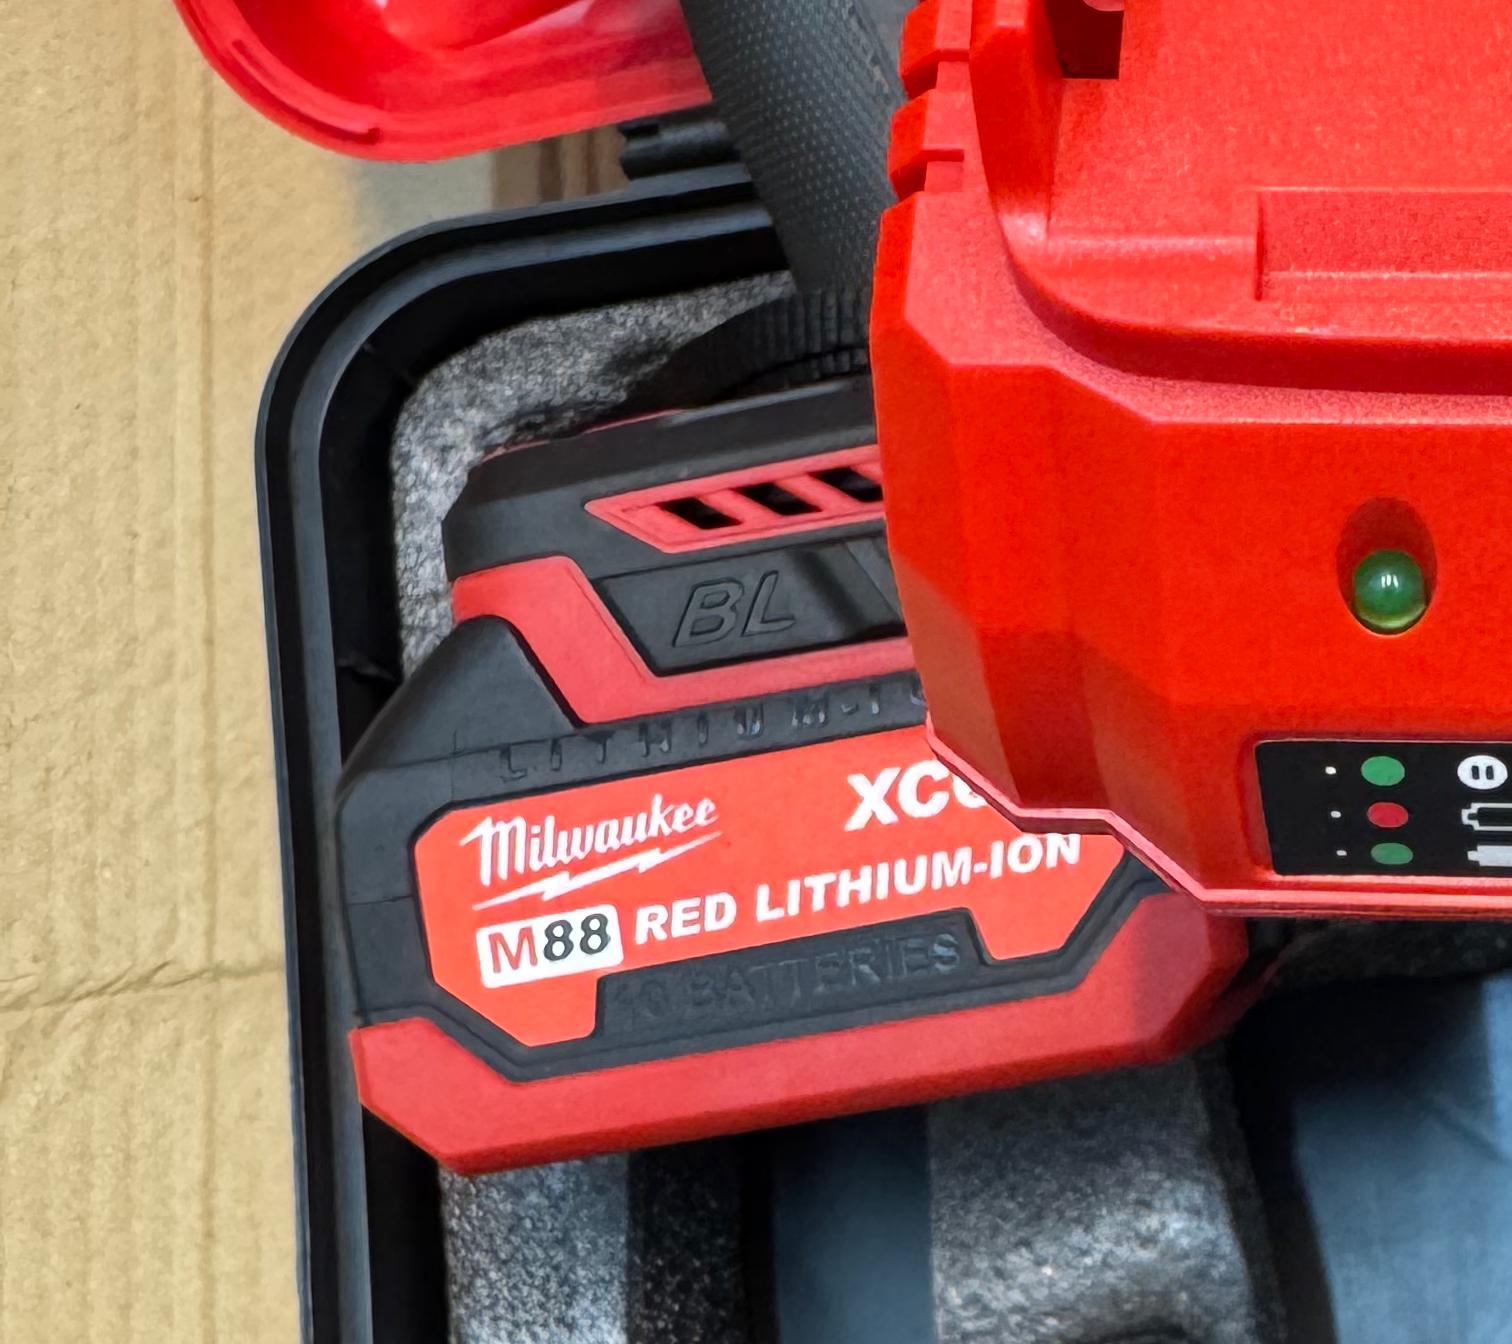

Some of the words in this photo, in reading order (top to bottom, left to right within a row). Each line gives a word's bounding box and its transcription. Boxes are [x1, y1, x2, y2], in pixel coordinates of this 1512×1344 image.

[672, 570, 795, 648] BL
[459, 793, 722, 888] Milwaukee
[488, 913, 612, 975] M88
[635, 892, 738, 946] RED
[755, 833, 1082, 923] LITHIUM-ION
[688, 933, 959, 1010] BATTERIES
